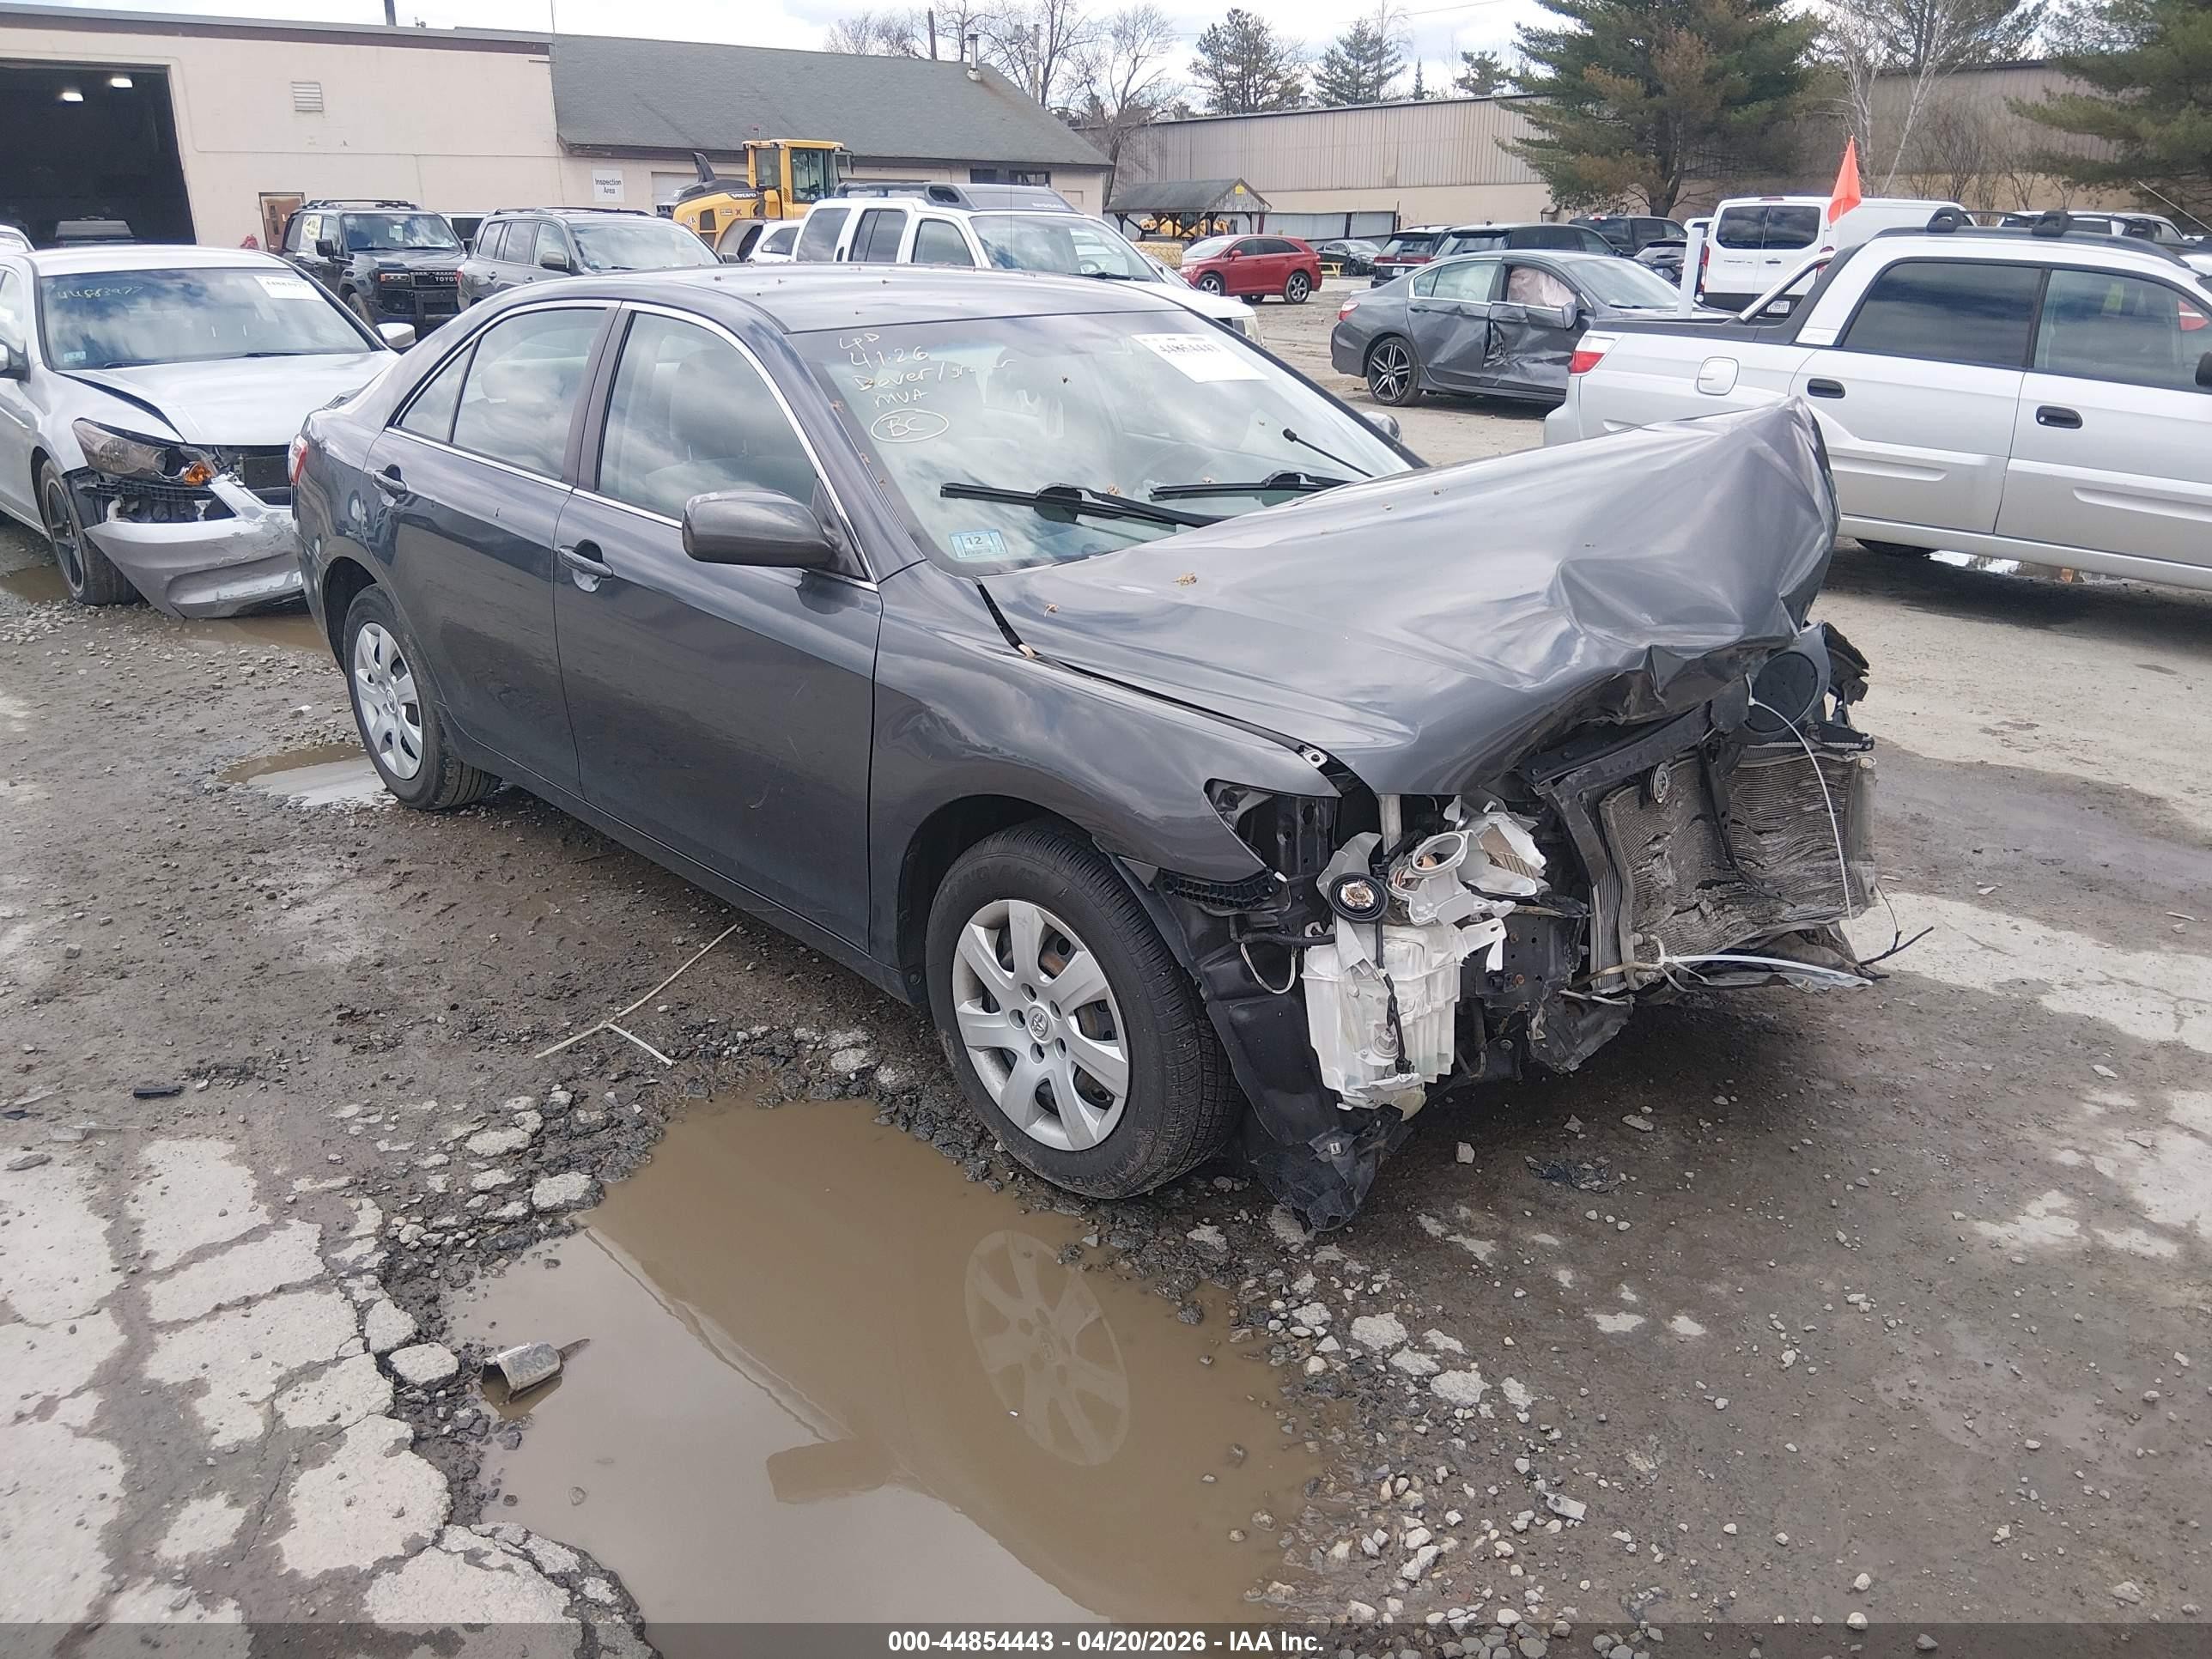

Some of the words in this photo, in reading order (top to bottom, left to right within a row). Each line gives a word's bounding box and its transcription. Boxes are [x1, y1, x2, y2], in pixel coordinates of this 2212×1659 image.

[594, 178, 623, 186] Inspection
[881, 416, 927, 437] BC
[966, 536, 983, 545] 12
